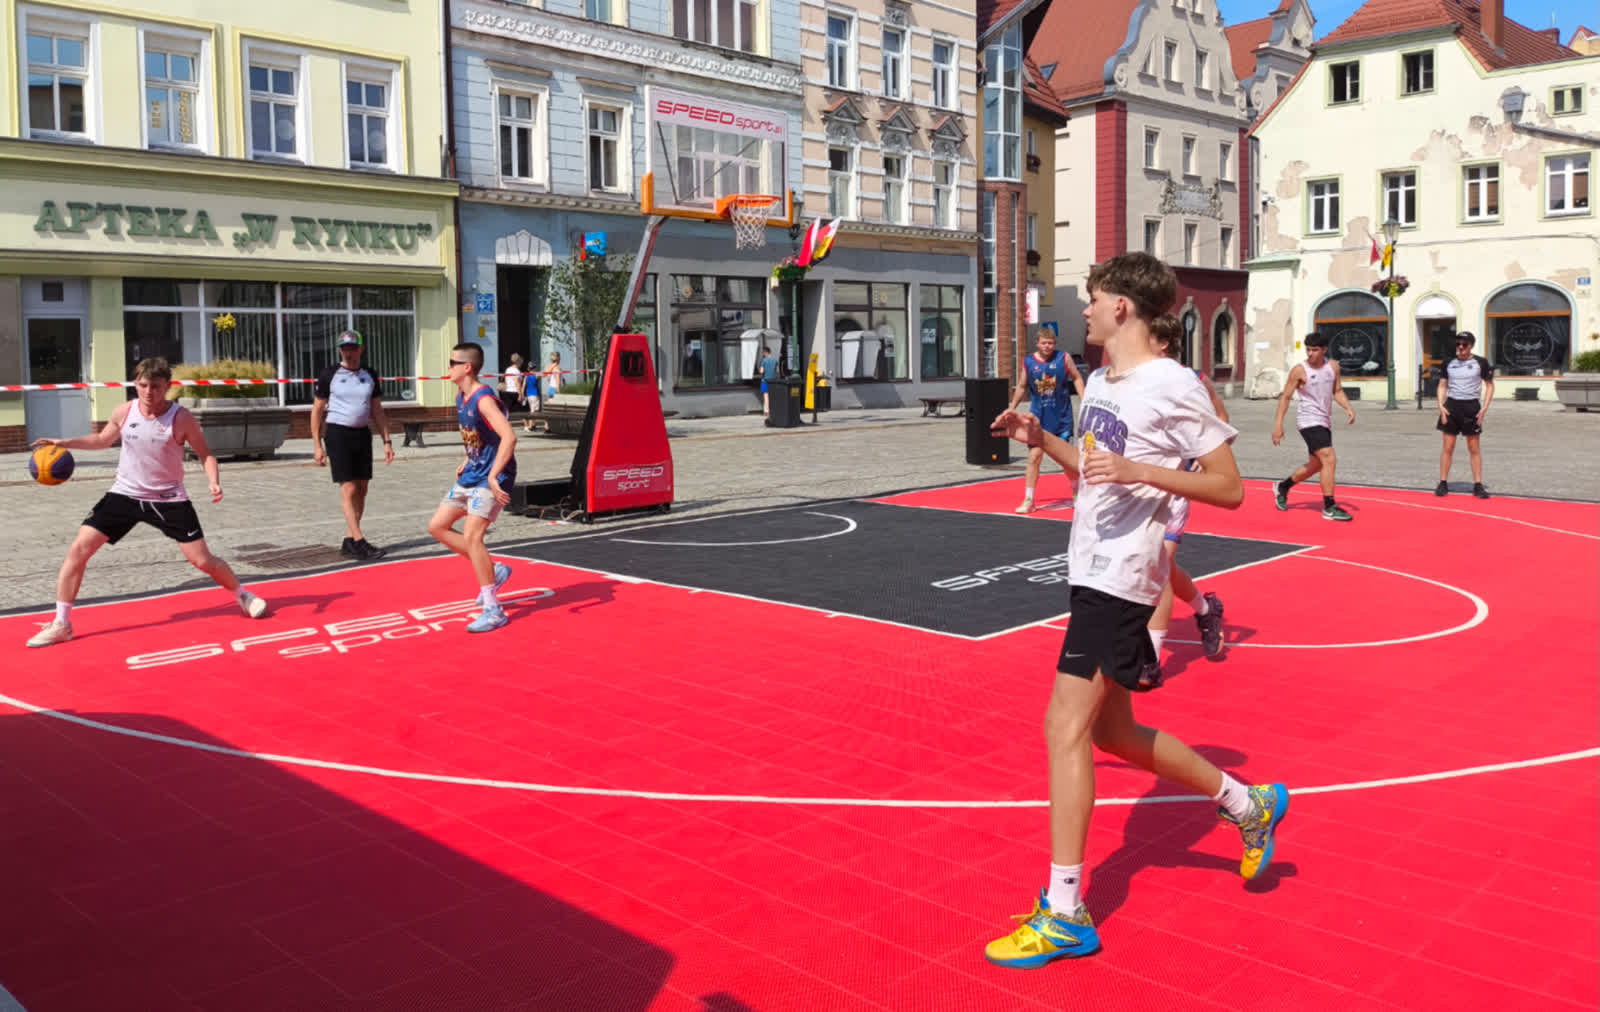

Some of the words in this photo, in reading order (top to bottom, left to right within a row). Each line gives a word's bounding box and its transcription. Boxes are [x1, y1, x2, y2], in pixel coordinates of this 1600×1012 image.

[656, 100, 735, 125] SPEED
[34, 200, 219, 240] APTEKA
[602, 466, 664, 481] SPEED
[617, 479, 650, 492] sport
[930, 552, 1069, 592] SPE
[125, 586, 556, 670] SPEED
[278, 611, 509, 659] spor
